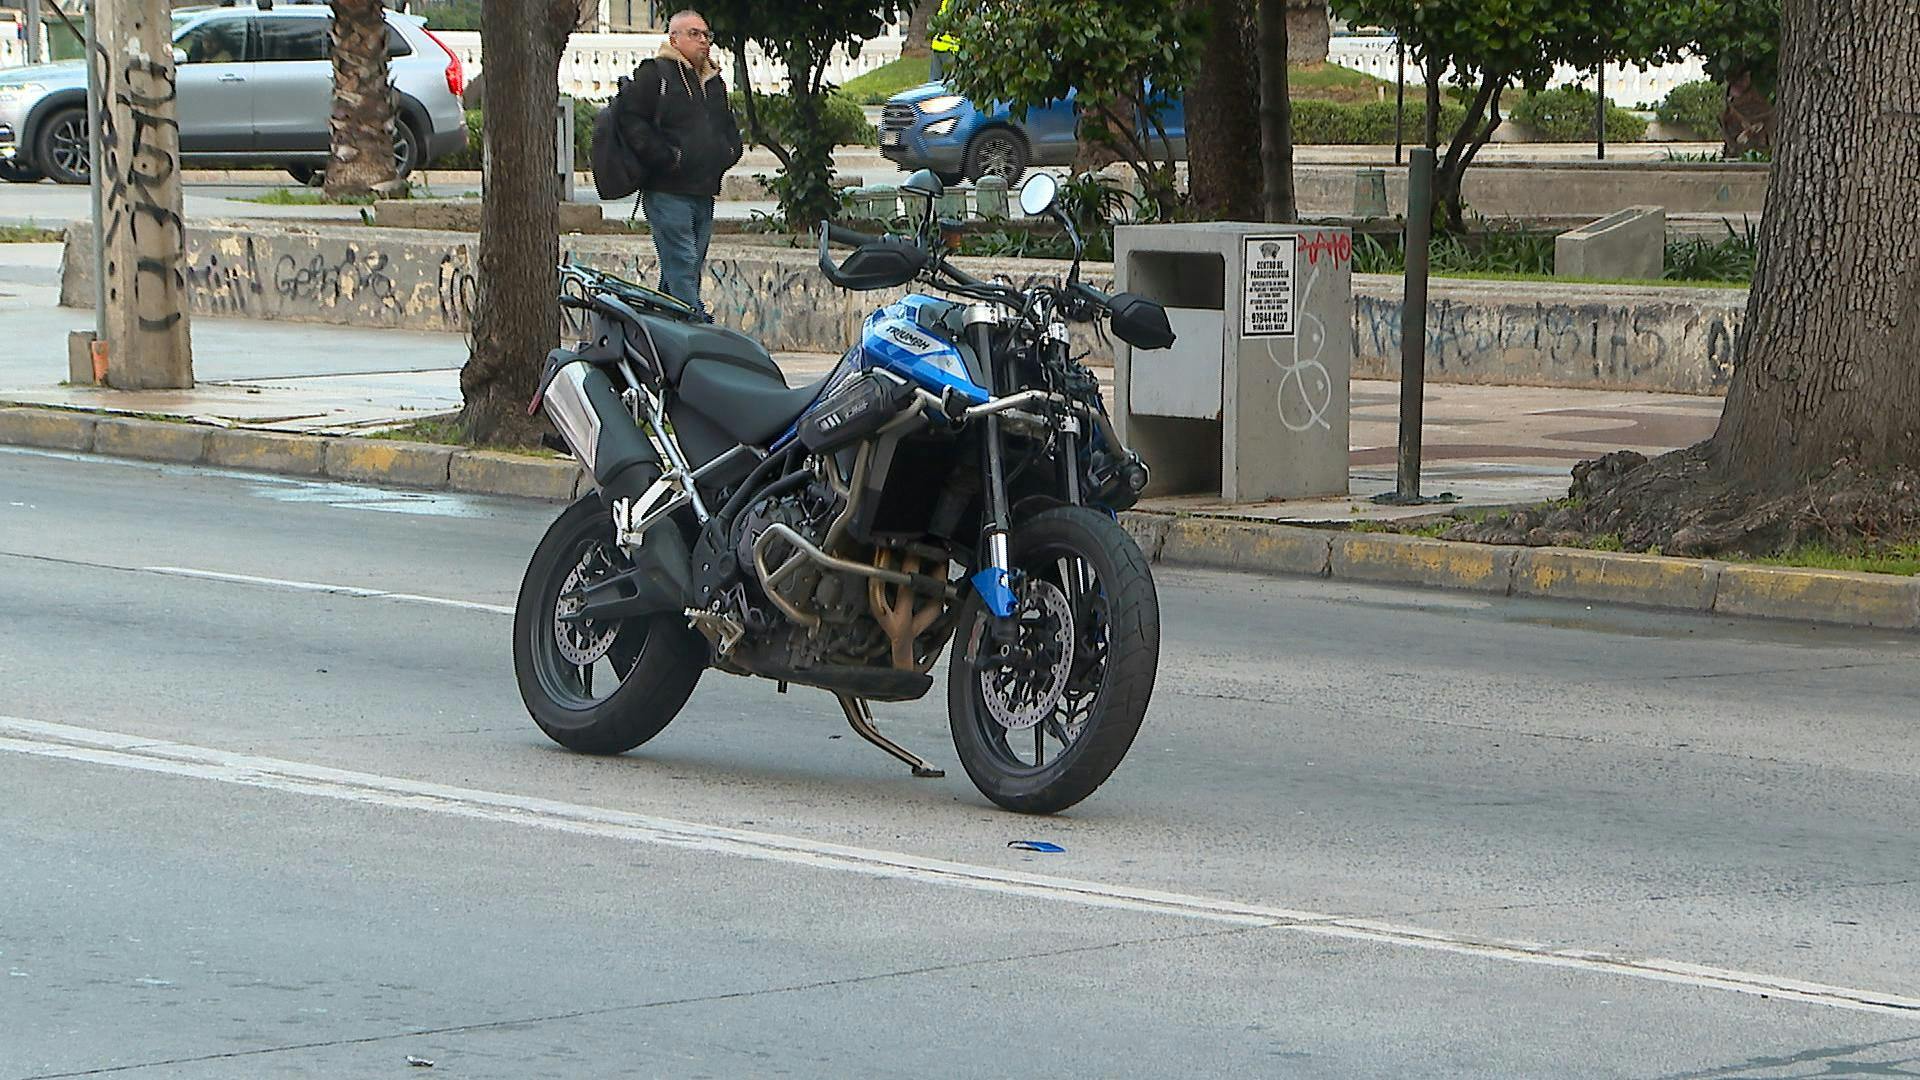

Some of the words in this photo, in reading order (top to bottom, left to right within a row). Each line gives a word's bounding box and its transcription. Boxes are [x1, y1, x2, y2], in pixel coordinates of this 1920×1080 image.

[1257, 260, 1276, 270] CENTRO
[1277, 260, 1284, 270] DE
[1265, 323, 1273, 331] DEL
[1274, 323, 1285, 331] MAR
[886, 326, 930, 350] TRIUMPH
